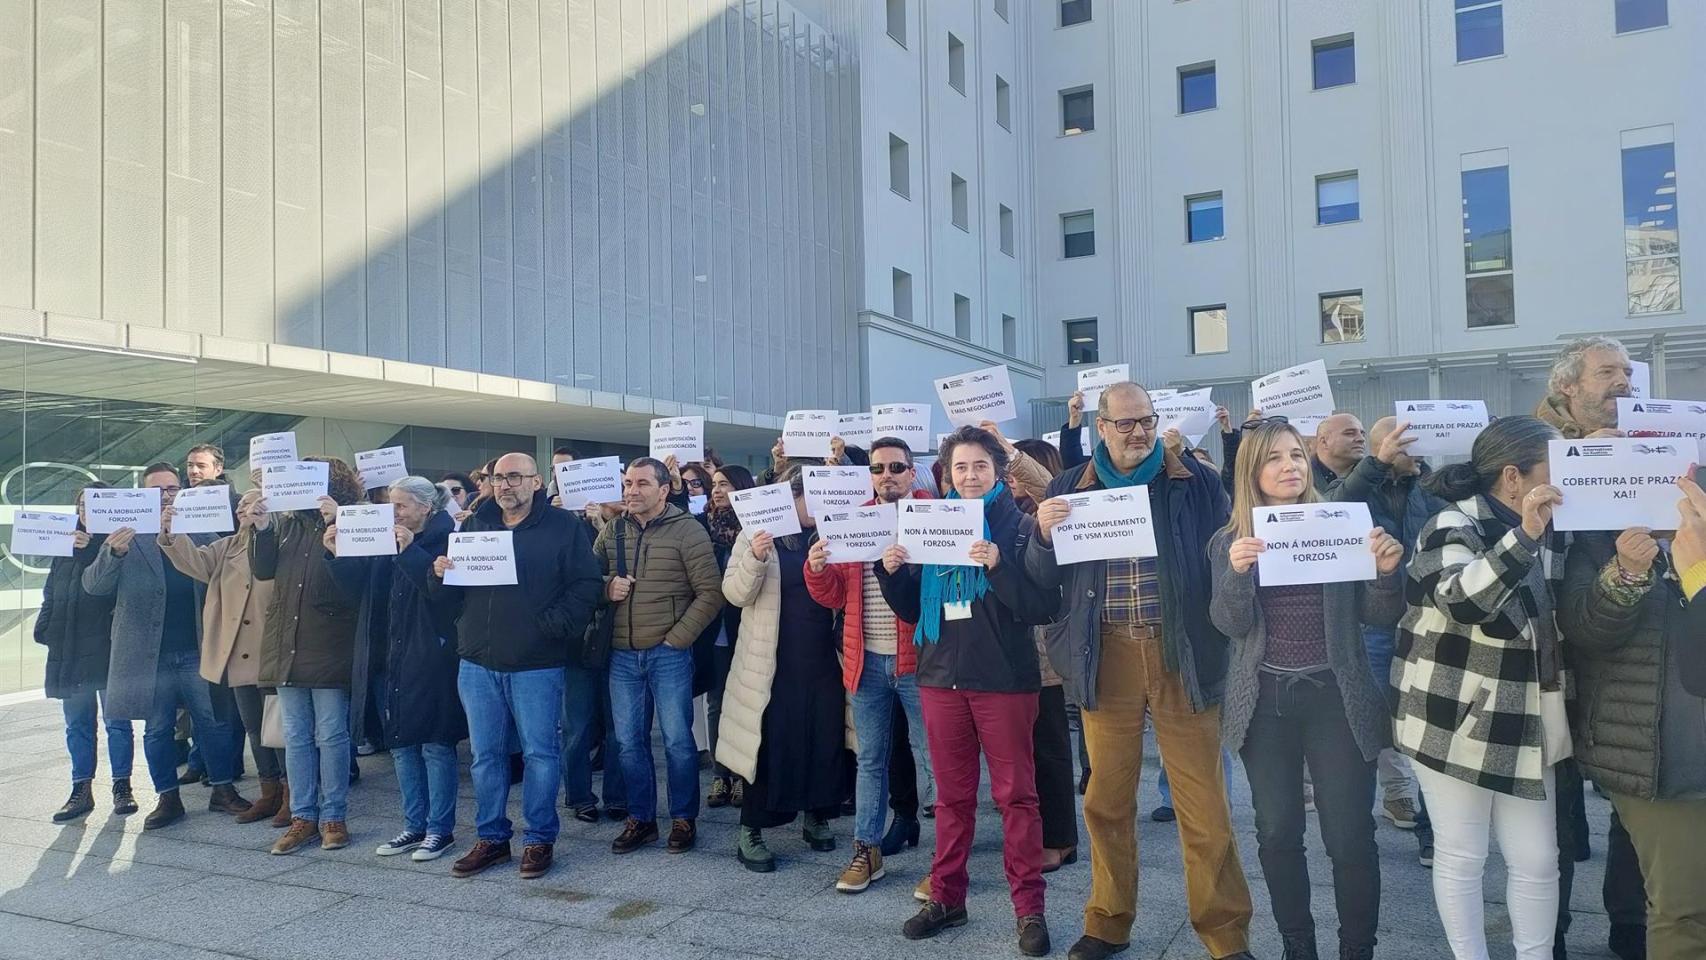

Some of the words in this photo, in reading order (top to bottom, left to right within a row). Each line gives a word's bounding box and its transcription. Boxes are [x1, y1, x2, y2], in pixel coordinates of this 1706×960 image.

[1259, 394, 1281, 403] MENOS
[1281, 384, 1321, 397] IMPOSICIÓNS
[1281, 392, 1323, 406] NEGOCIACIÓN
[1562, 476, 1627, 486] COBERTURA
[1630, 476, 1644, 485] DE
[1647, 476, 1687, 485] PRAZ
[1613, 489, 1637, 499] XA!!
[751, 504, 792, 517] COMPLEMENTO
[355, 526, 388, 534] MOBILIDADE
[1057, 524, 1074, 533] POR
[1074, 522, 1087, 530] UN
[1087, 516, 1147, 529] COMPLEMENTO
[826, 533, 842, 541] NON
[849, 530, 893, 539] MOBILIDADE
[929, 528, 975, 536] MOBILIDADE
[1073, 533, 1083, 541] DE
[1085, 532, 1102, 540] VSM
[1103, 529, 1134, 538] XUSTO!!
[1266, 541, 1289, 550] NON
[1301, 537, 1364, 548] MOBILIDADE
[1293, 552, 1338, 562] FORZOSA
